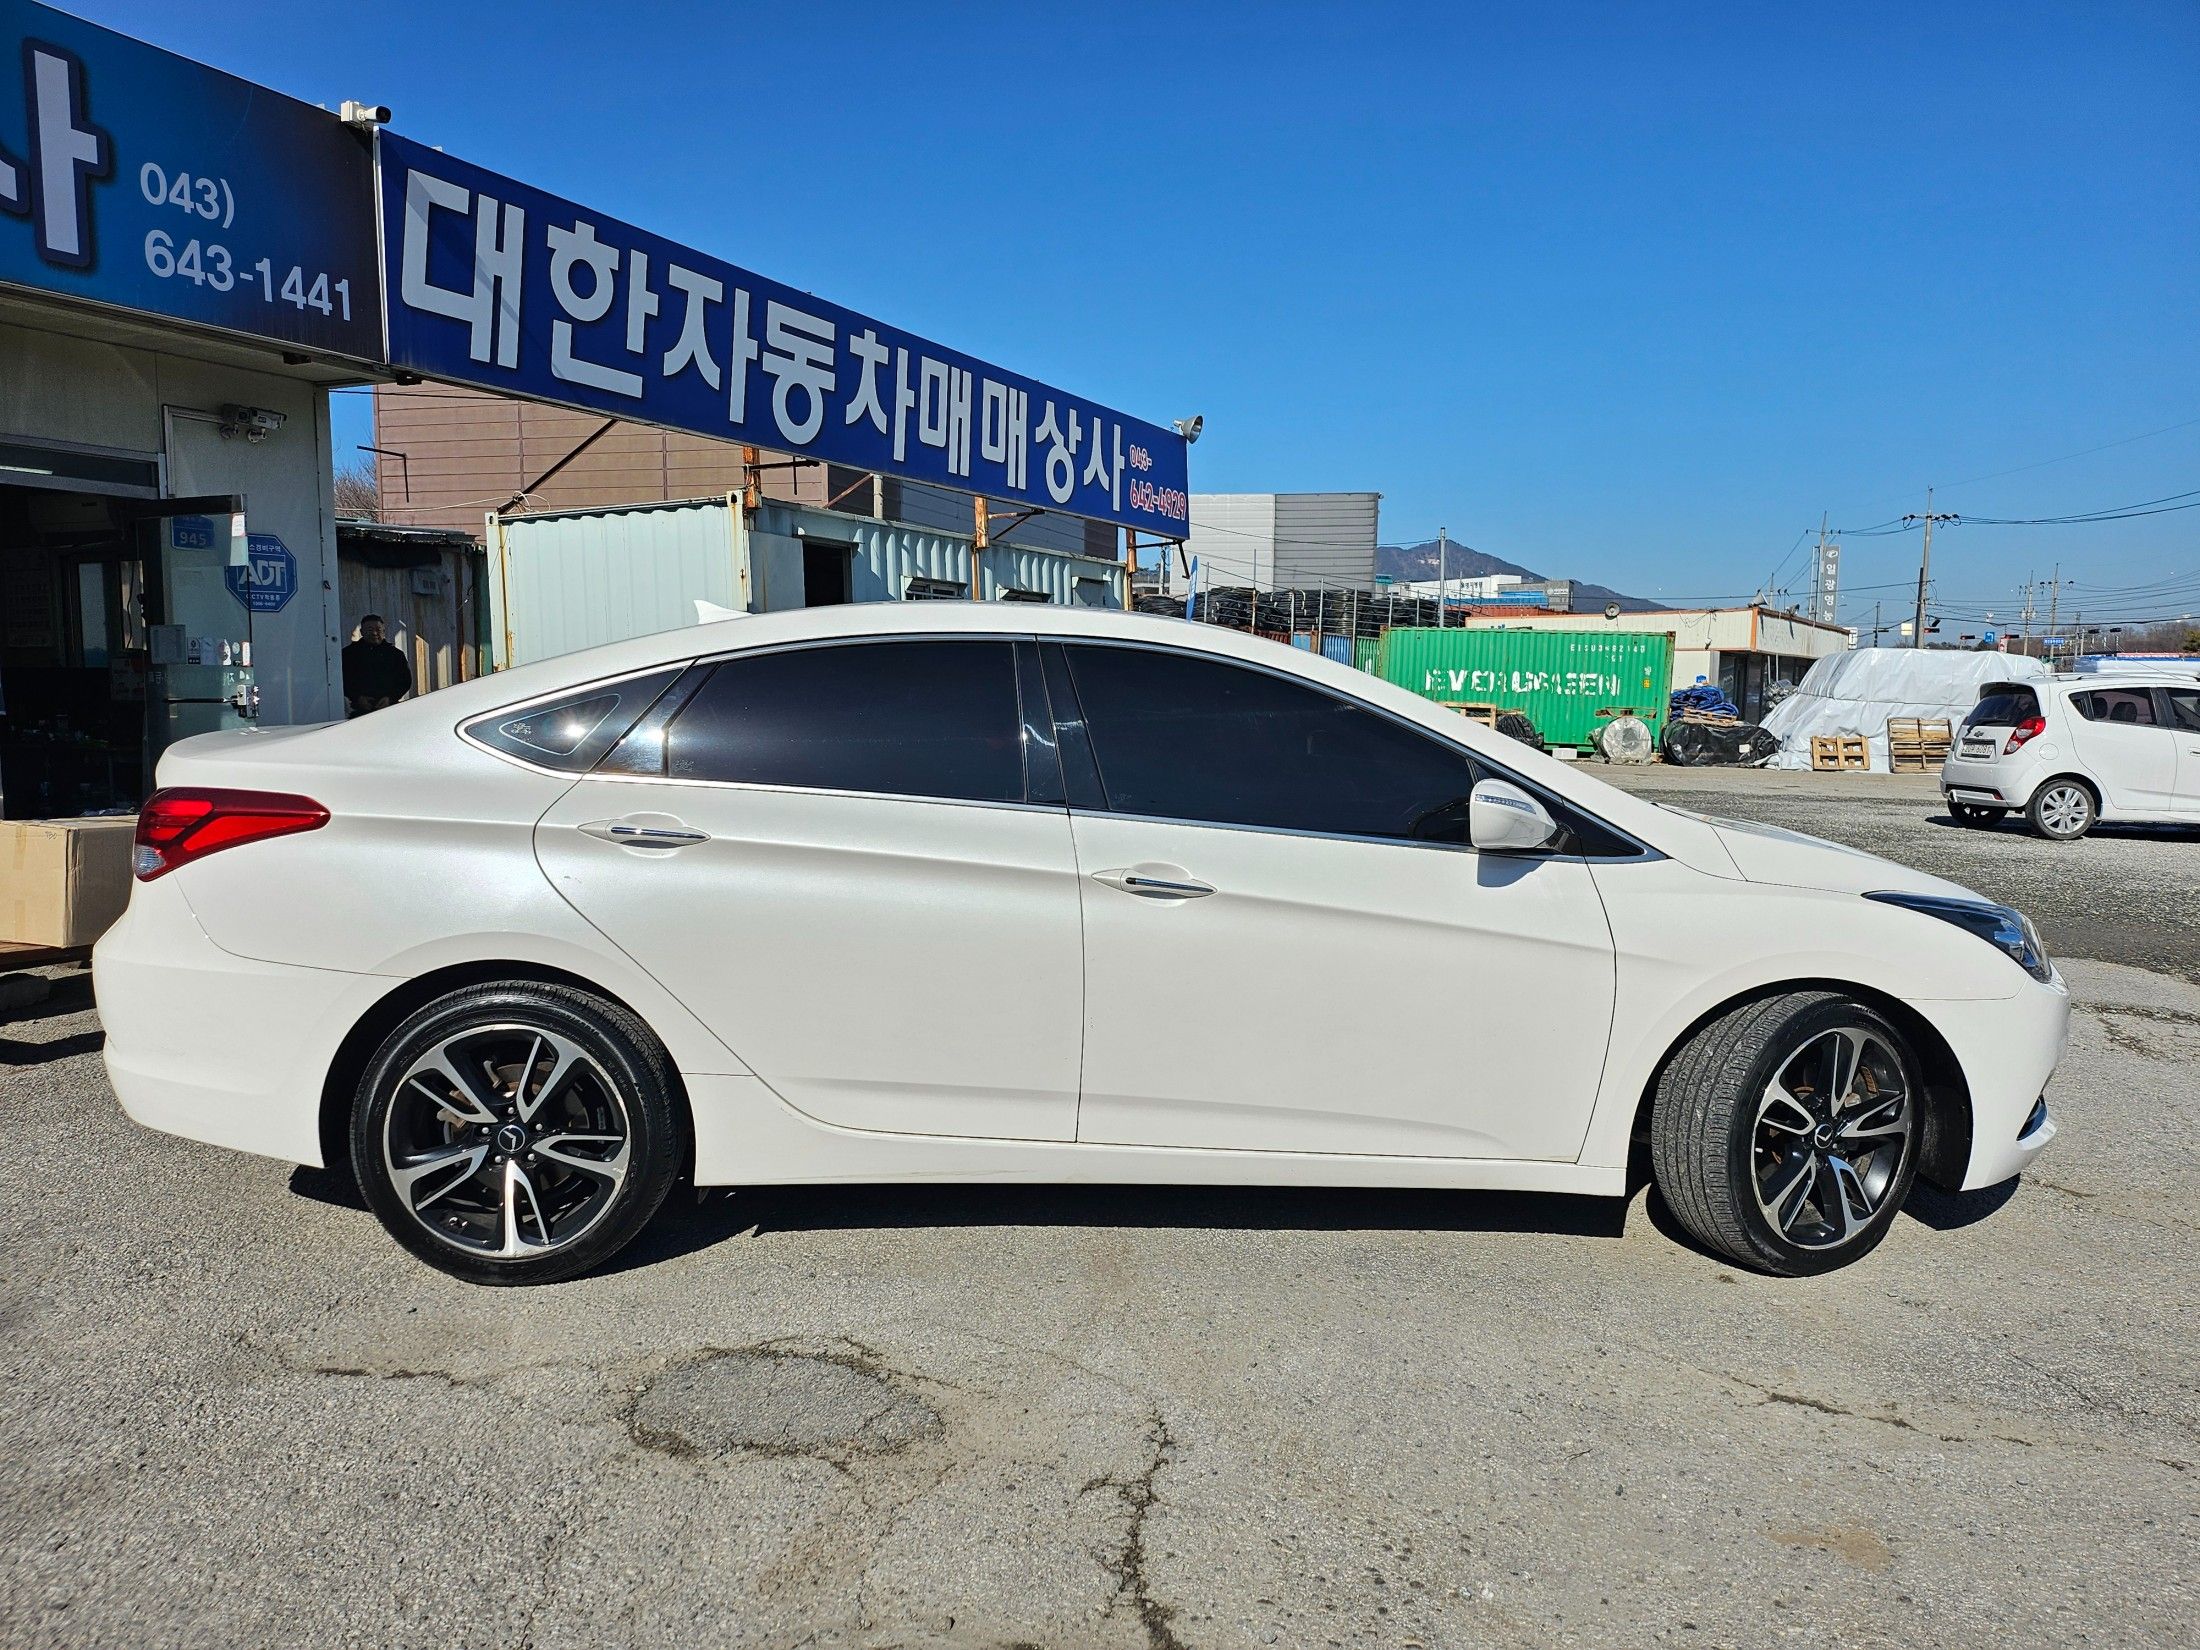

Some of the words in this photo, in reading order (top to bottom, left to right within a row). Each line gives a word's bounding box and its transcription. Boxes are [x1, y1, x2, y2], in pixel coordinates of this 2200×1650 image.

[140, 162, 235, 229] 043)
[145, 229, 351, 321] 643-1441
[402, 168, 1126, 512] 대한자동차매매상사
[1130, 444, 1153, 471] 043-
[1130, 478, 1187, 520] 642-4929
[180, 531, 207, 545] 945
[249, 543, 281, 553] 스경비구역
[239, 559, 286, 587] ADT
